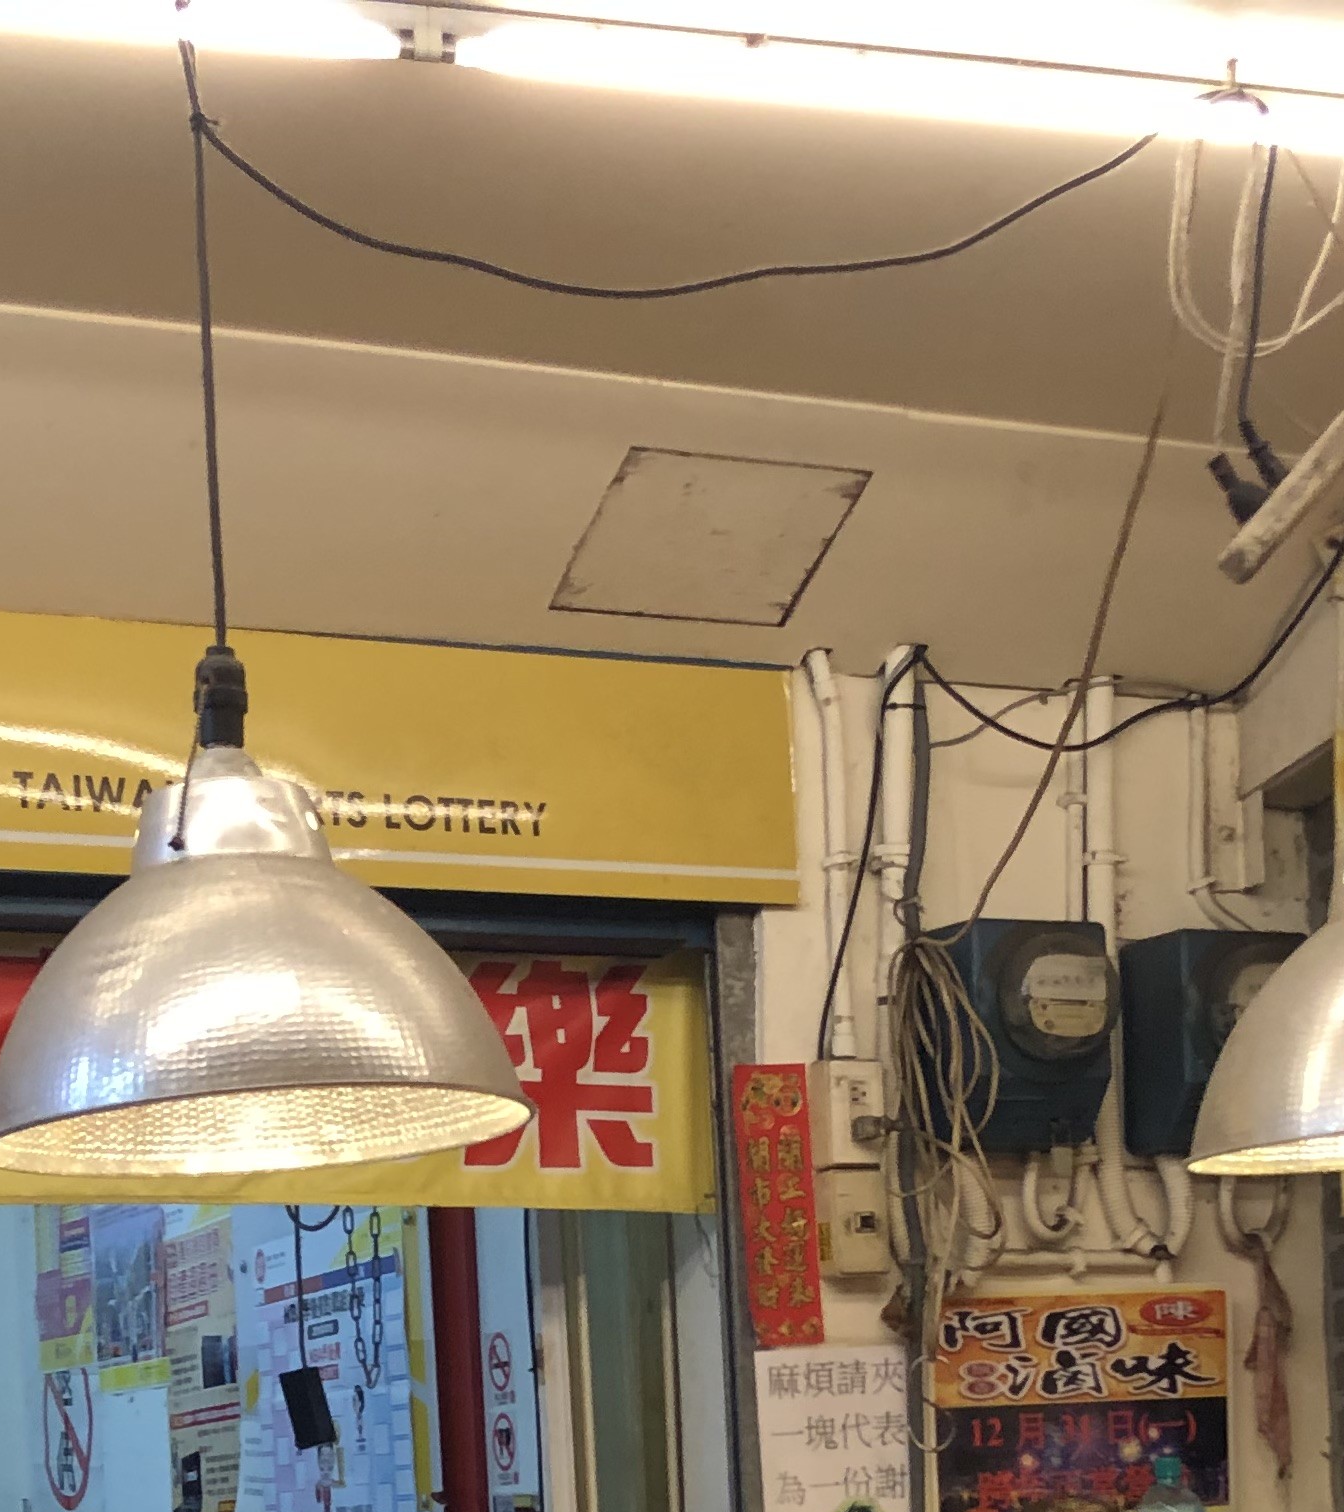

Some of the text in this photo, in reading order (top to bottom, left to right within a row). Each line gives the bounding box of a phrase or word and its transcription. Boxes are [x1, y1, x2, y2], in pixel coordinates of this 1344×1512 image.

[13, 770, 174, 815] TAIWA
[385, 794, 547, 838] LOTTERY
[941, 1304, 1124, 1350] 阿國
[767, 1356, 906, 1400] 麻煩請夾
[769, 1410, 907, 1451] 一塊代表
[775, 1463, 908, 1507] 為一份謝
